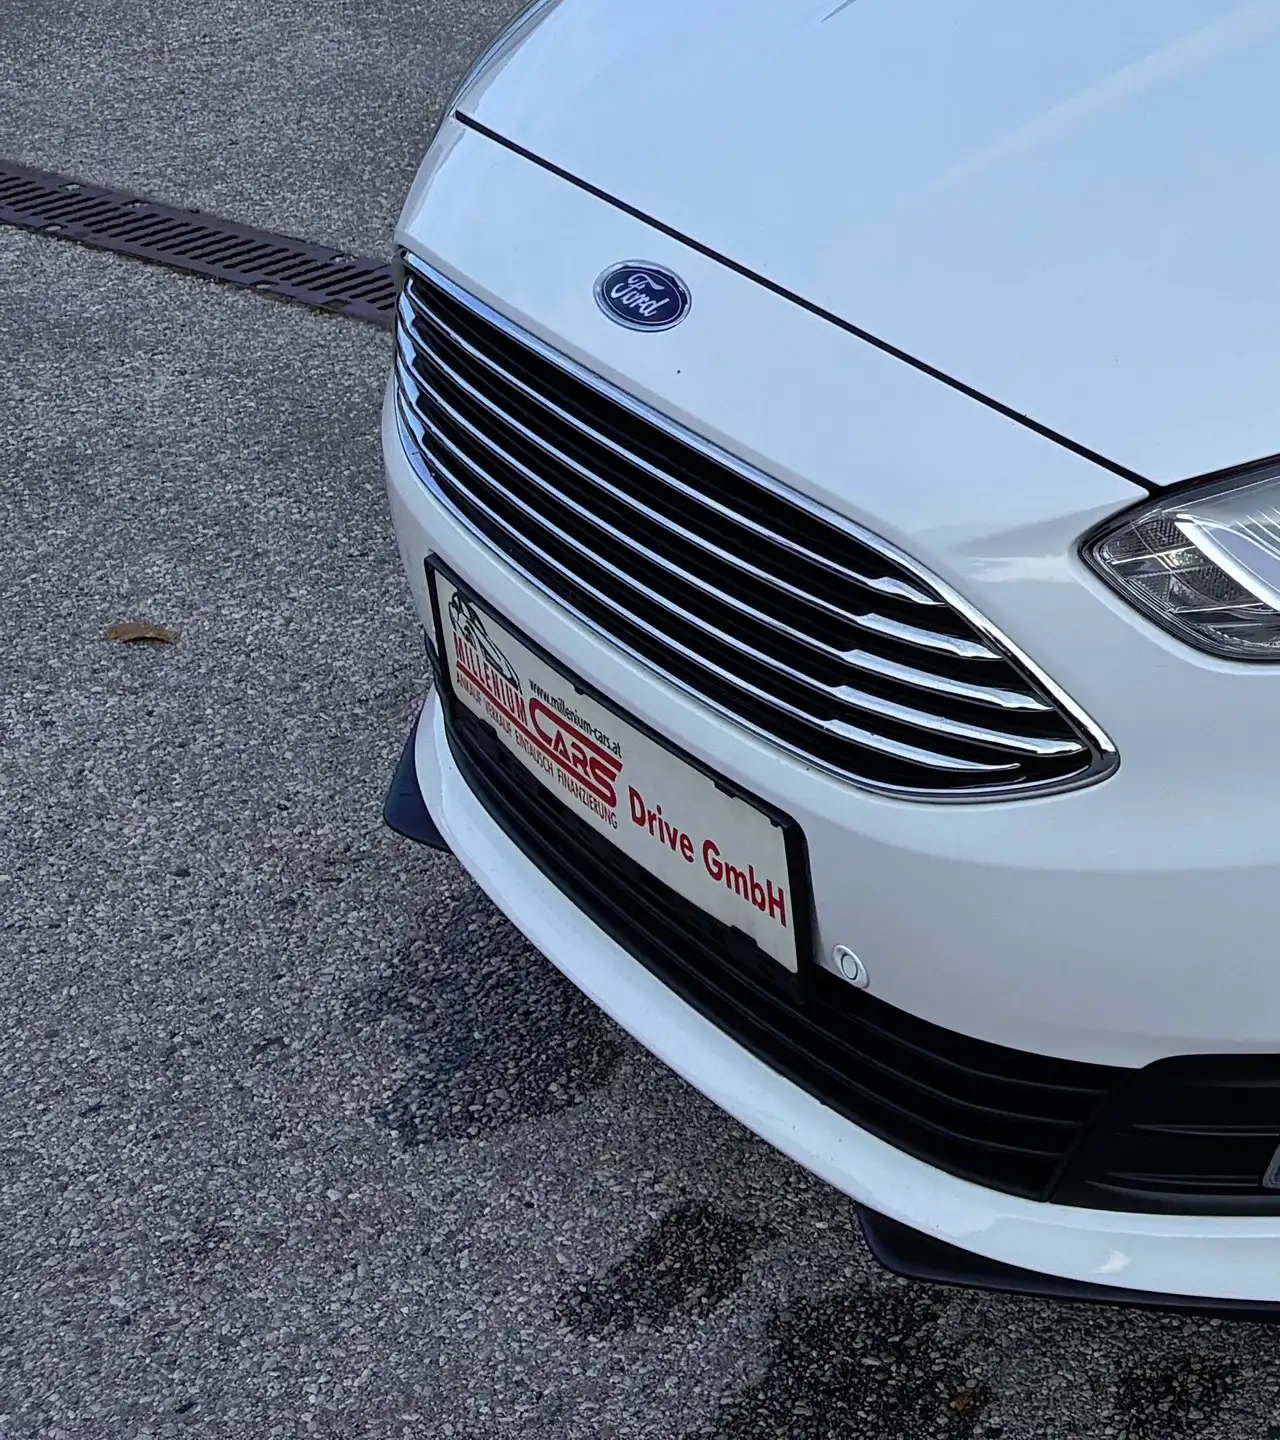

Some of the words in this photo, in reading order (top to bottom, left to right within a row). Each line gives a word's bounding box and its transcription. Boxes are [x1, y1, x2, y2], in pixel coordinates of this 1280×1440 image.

[610, 273, 671, 317] Ford
[528, 678, 623, 759] www.millenium-cars.at
[453, 629, 529, 728] MILLENIUM
[528, 697, 623, 808] CARS
[628, 784, 696, 864] Drive
[701, 838, 788, 929] GmbH
[515, 729, 554, 780] EINTAUSCH
[557, 767, 618, 830] FINANZIERUNG
